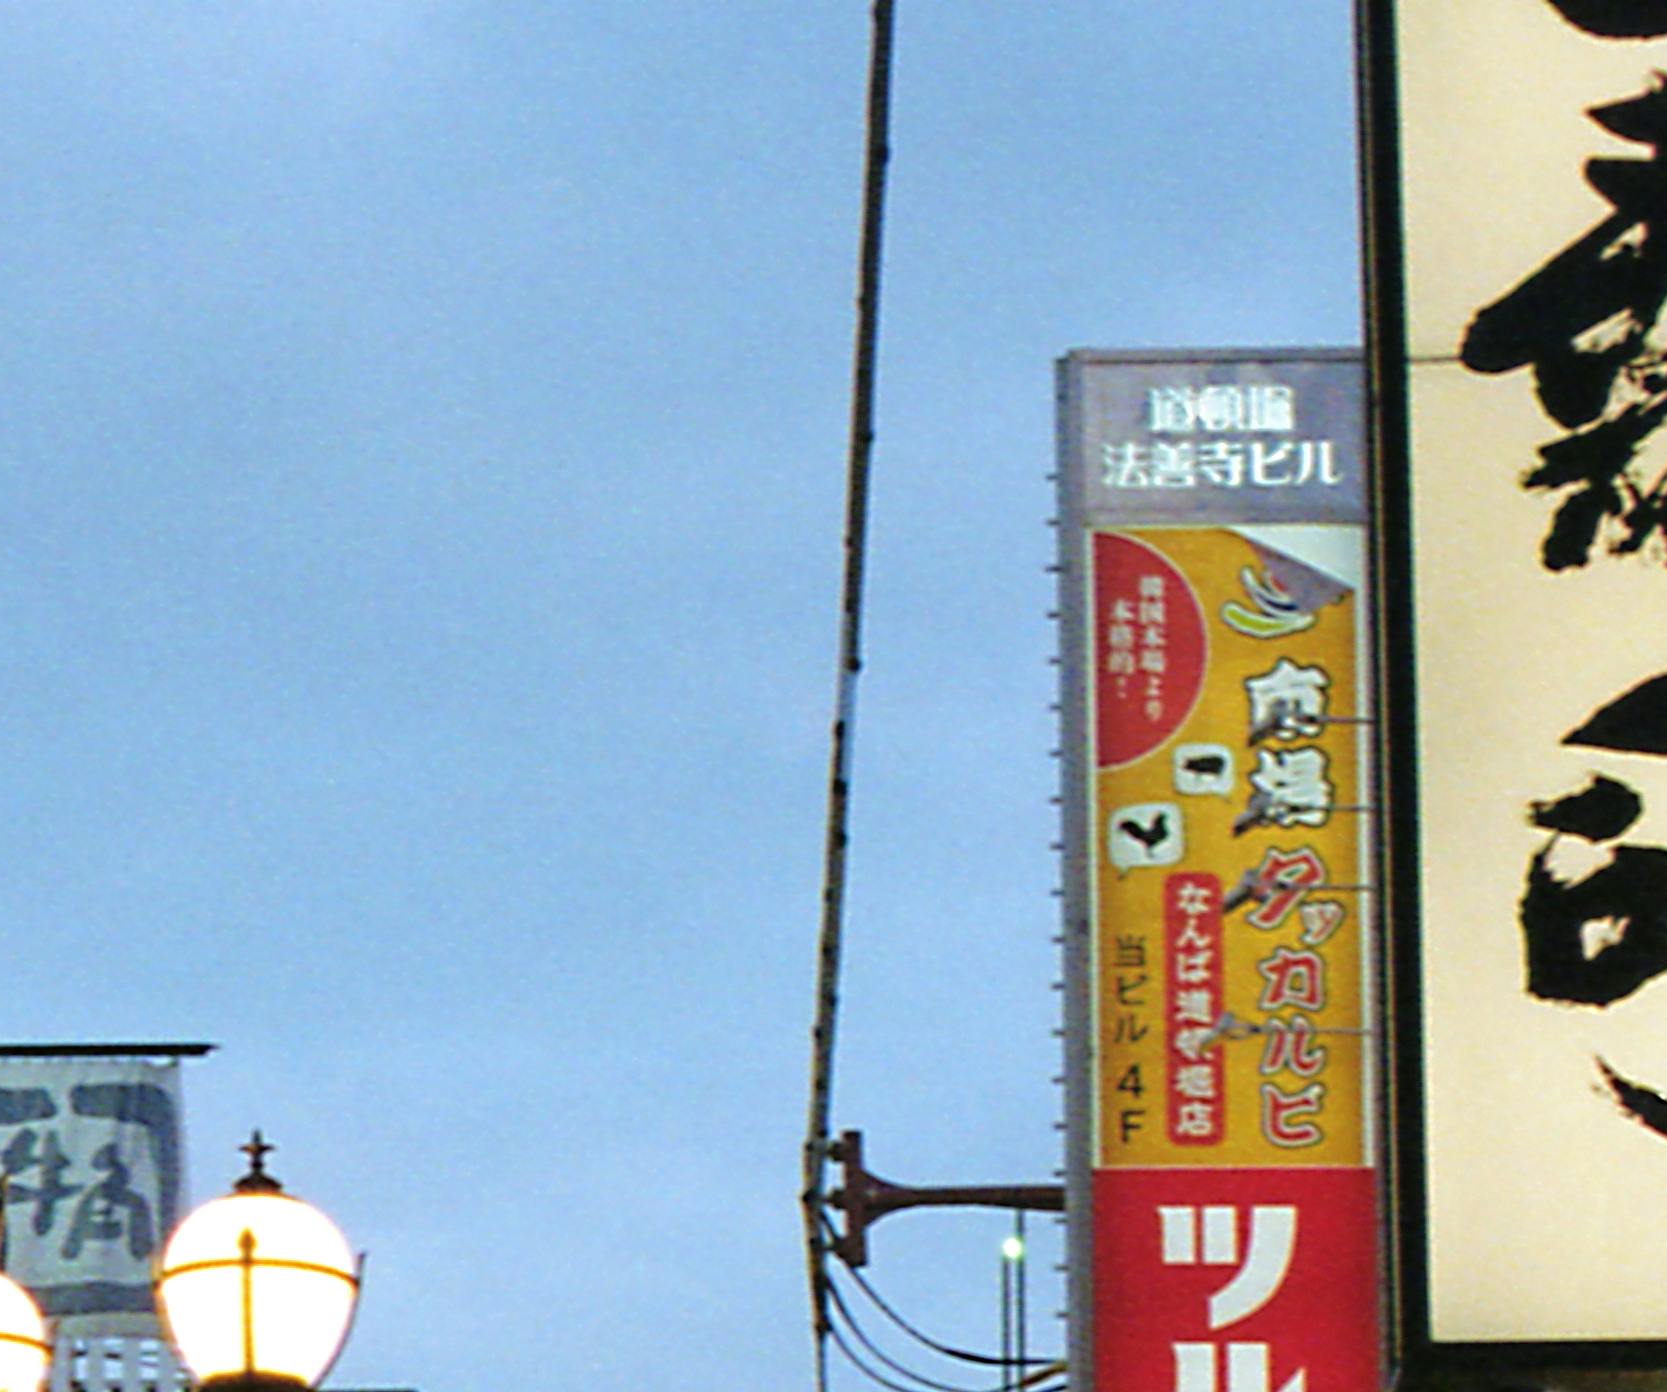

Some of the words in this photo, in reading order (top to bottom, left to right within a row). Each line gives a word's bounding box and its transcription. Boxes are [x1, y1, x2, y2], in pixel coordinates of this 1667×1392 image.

[1102, 440, 1344, 489] 法善寺ビル
[1117, 1063, 1146, 1144] 4F
